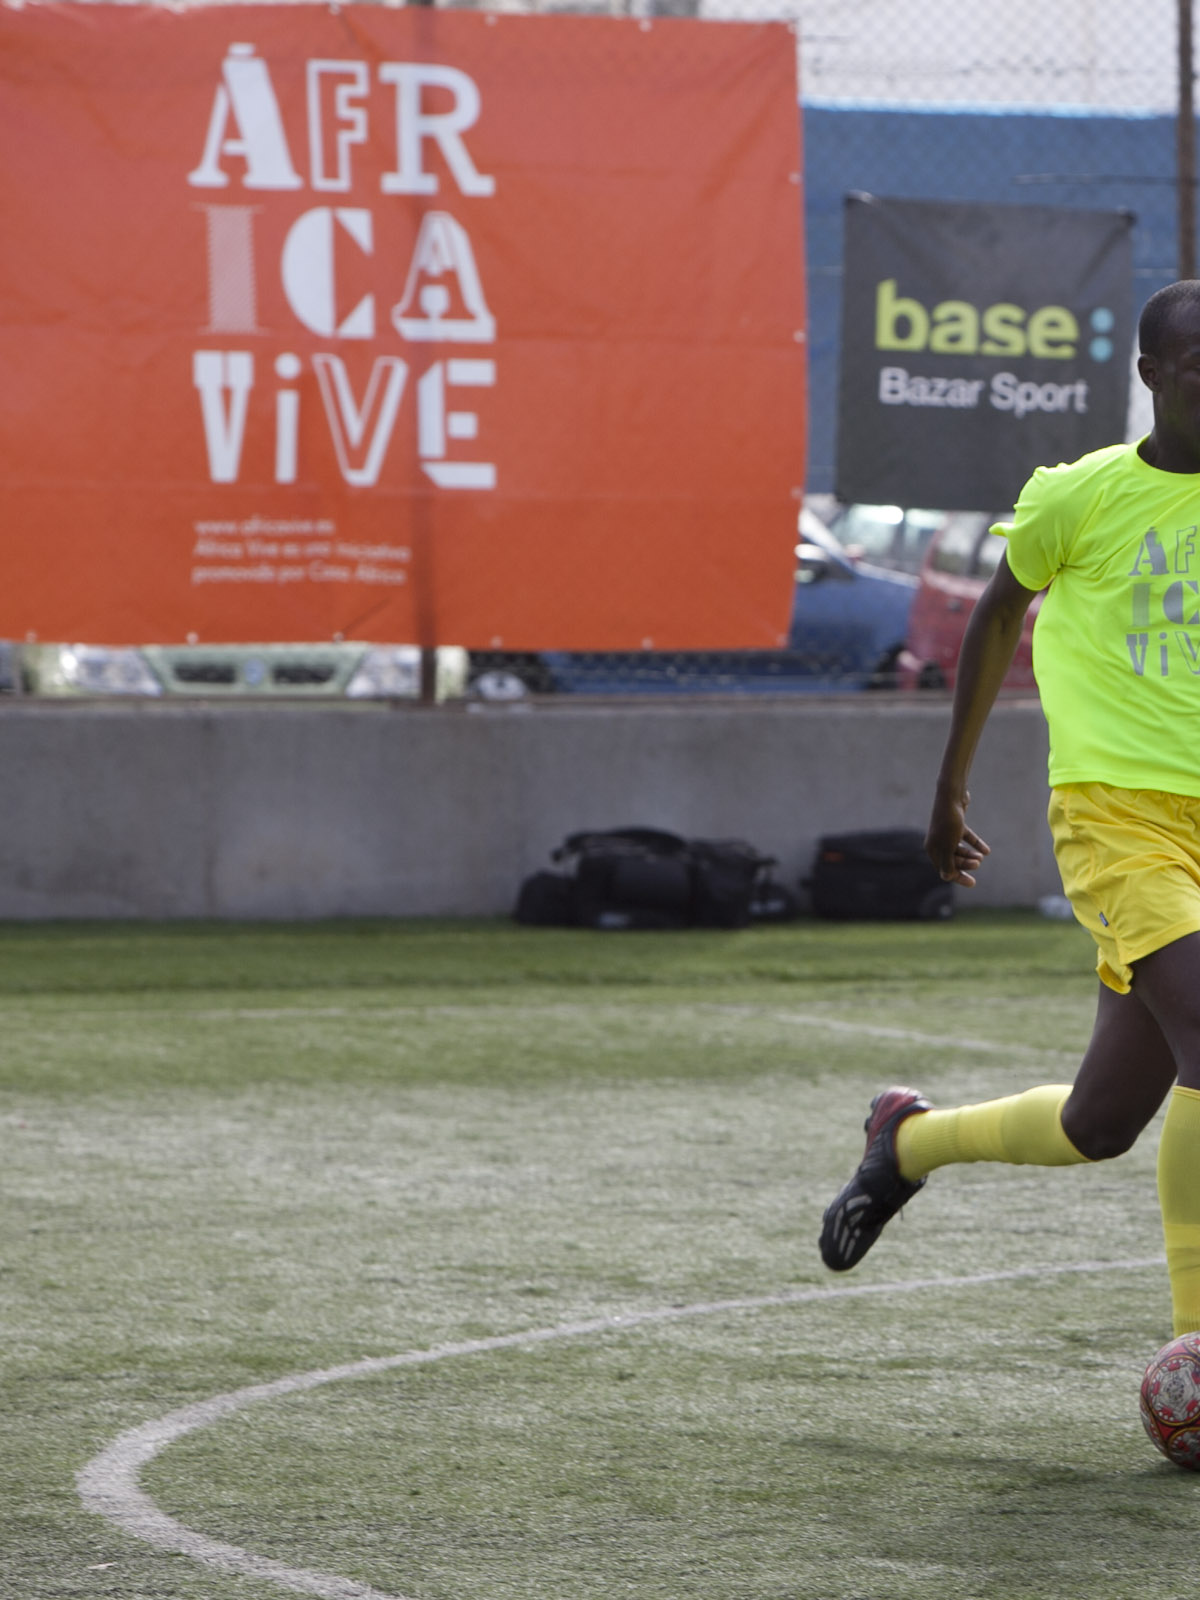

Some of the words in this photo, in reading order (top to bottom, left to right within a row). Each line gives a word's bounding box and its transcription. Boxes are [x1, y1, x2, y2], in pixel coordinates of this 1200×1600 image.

[192, 201, 496, 343] ICA
[879, 366, 985, 409] Bazar
[990, 372, 1089, 418] Sport
